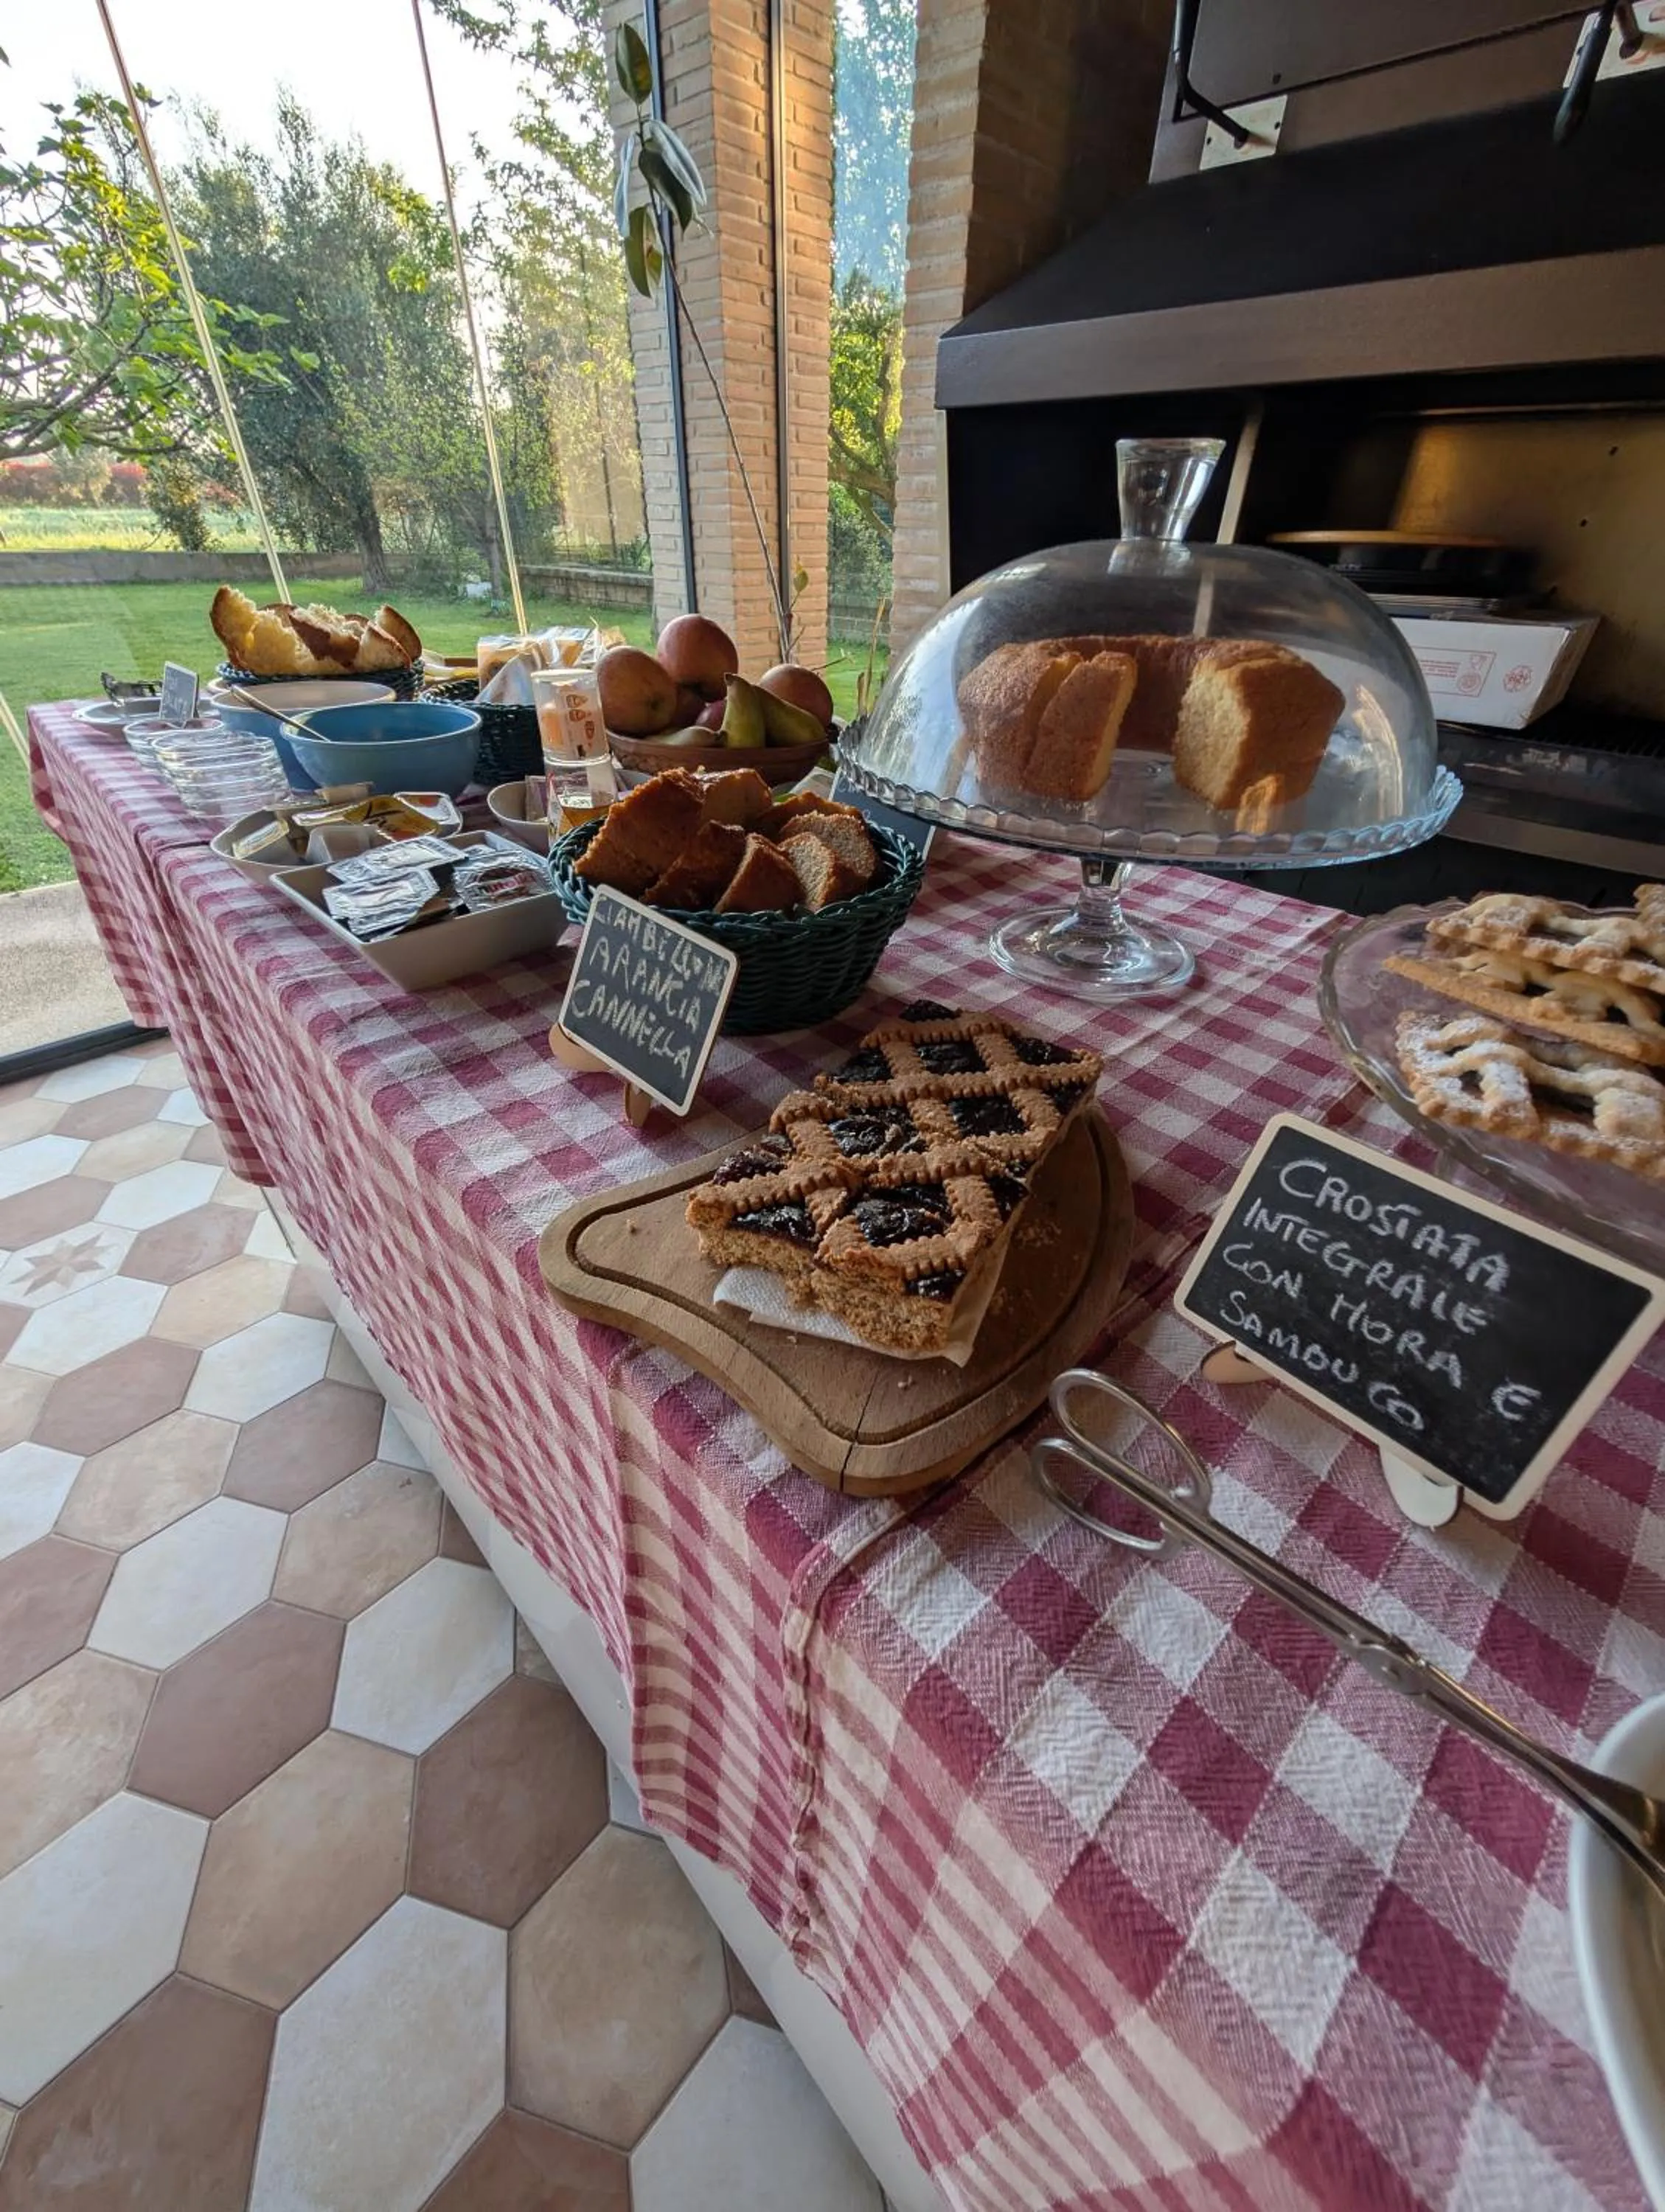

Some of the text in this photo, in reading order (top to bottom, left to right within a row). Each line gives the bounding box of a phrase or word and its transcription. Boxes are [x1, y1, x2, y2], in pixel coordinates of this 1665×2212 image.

[571, 979, 691, 1080] CANNELLA
[589, 935, 701, 1033] ARANCIA
[1243, 1197, 1489, 1334] INTEGRALE
[1278, 1158, 1510, 1293] CROSTATA
[1223, 1242, 1543, 1422] CON MORA E
